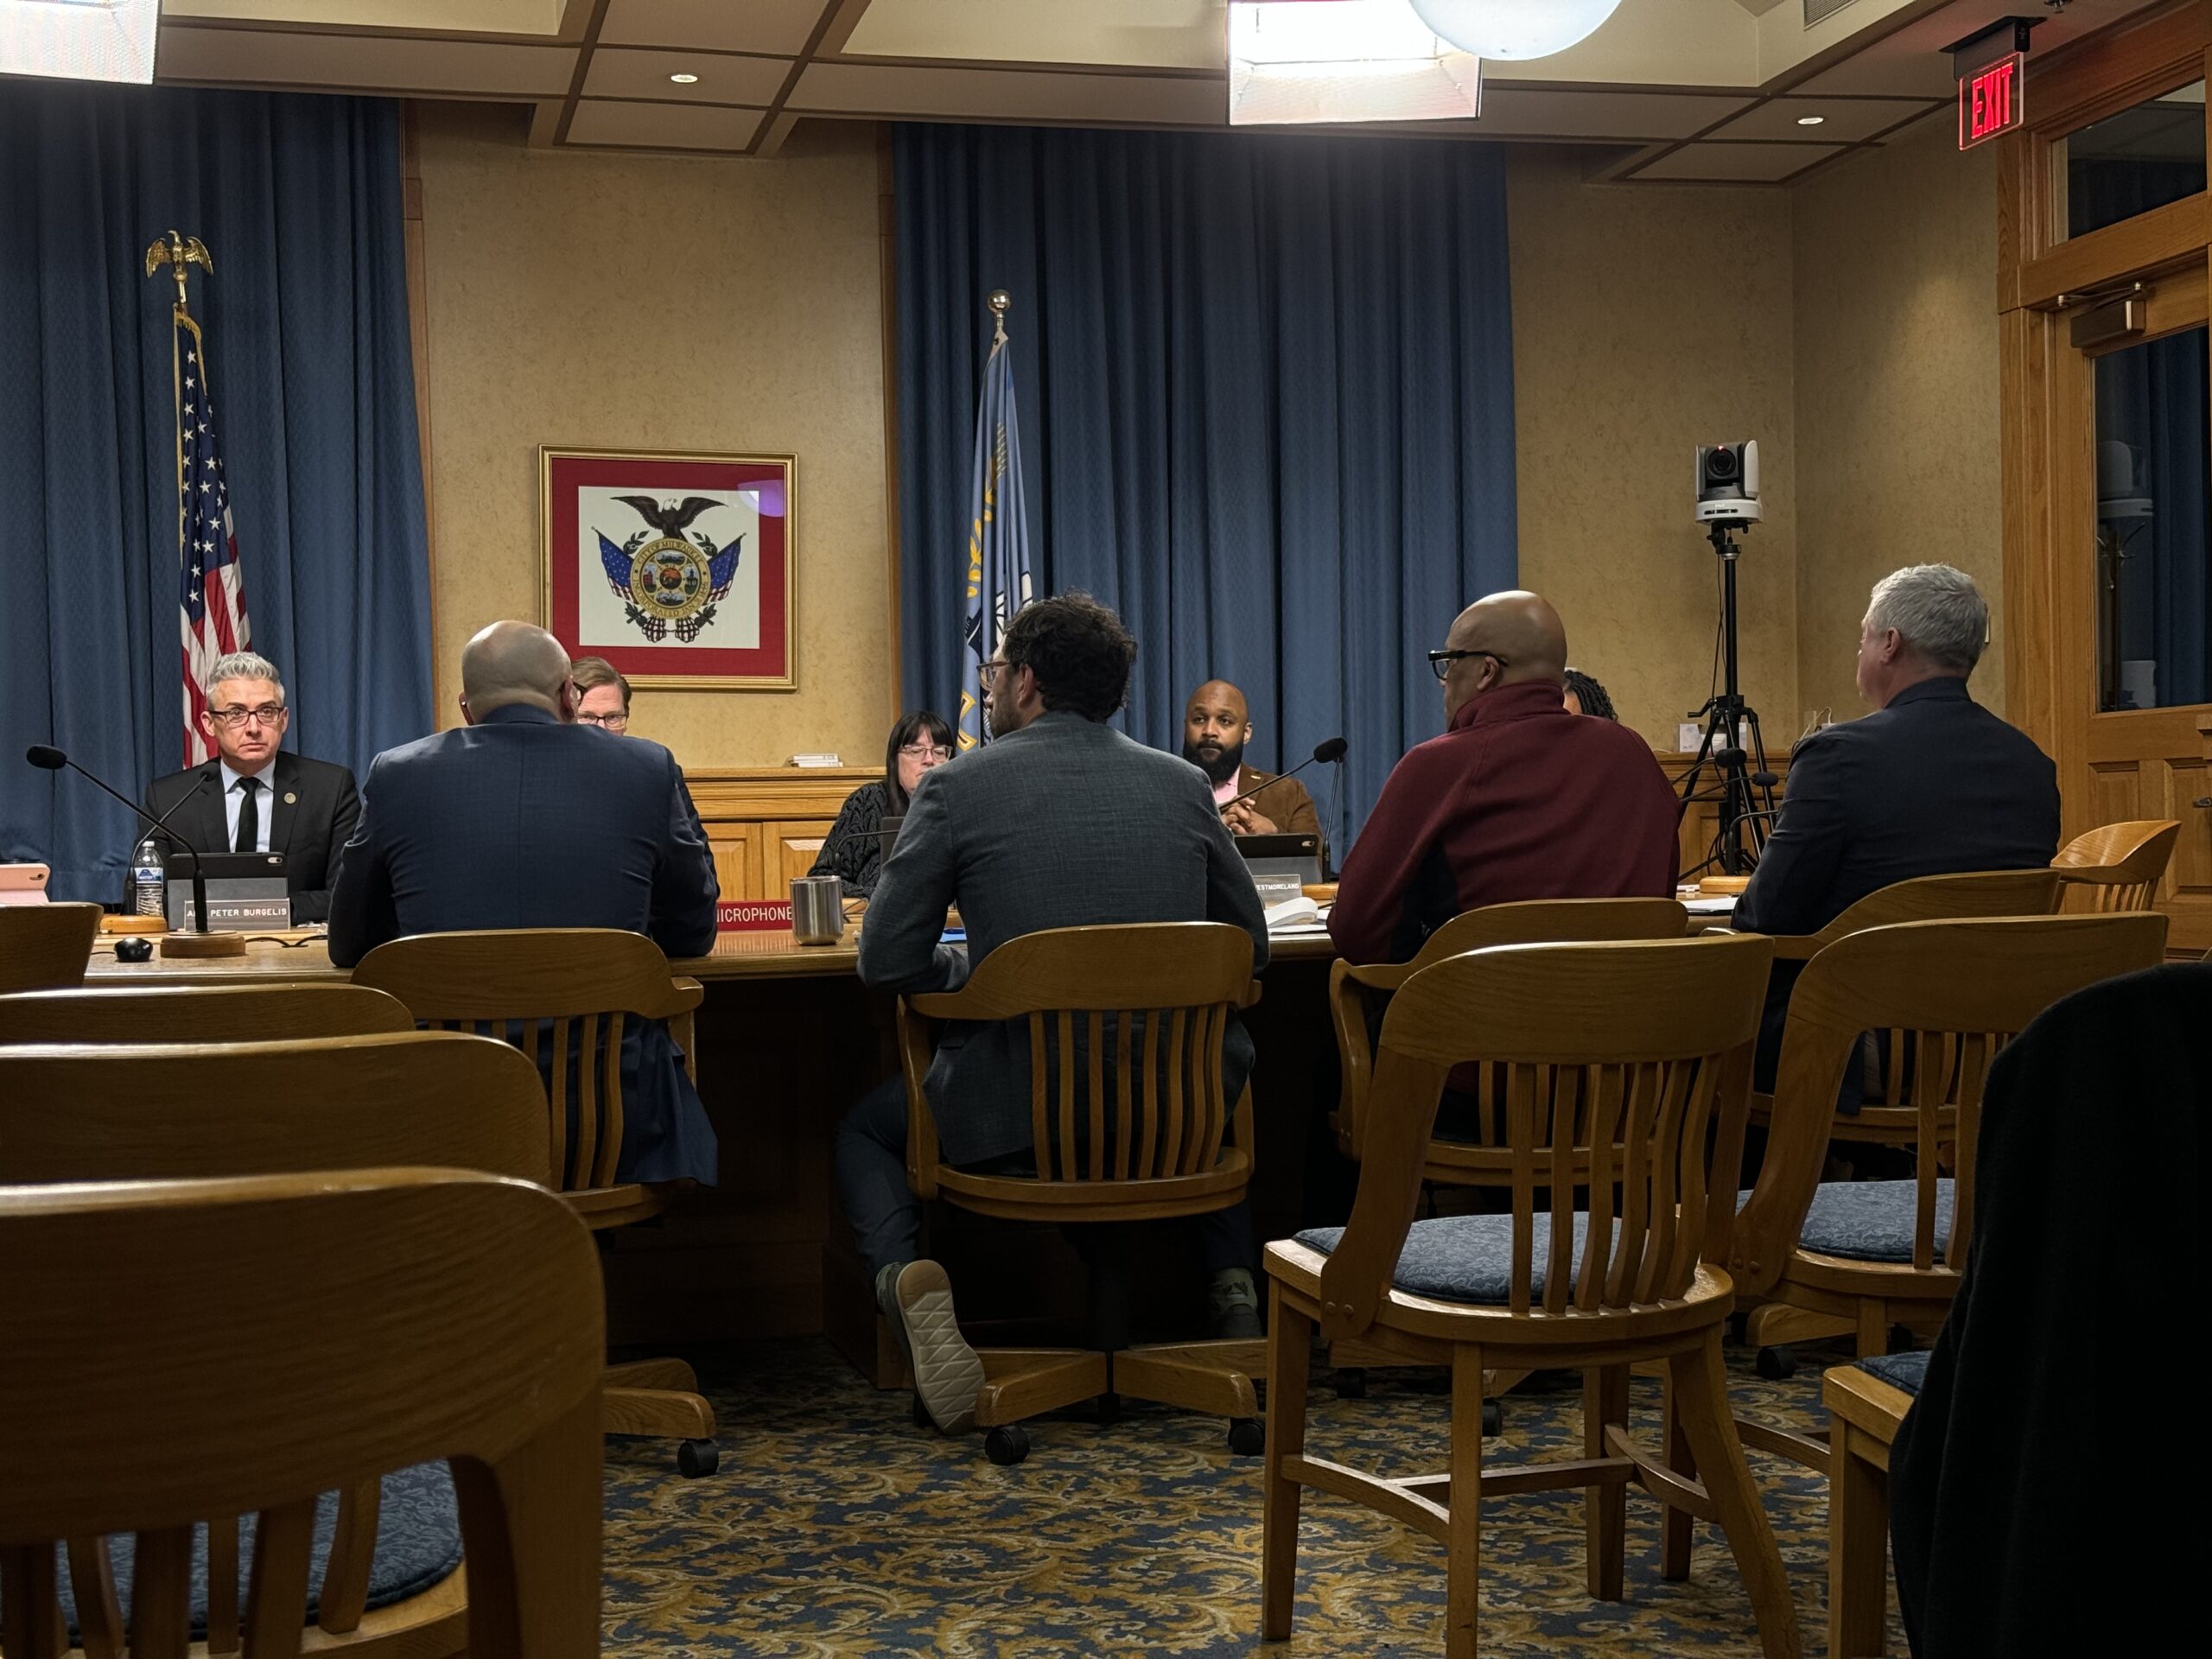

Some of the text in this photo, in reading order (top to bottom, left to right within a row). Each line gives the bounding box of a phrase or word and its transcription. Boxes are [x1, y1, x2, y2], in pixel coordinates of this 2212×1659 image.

[1972, 62, 2013, 139] EXIT
[243, 907, 287, 916] BURGELIS
[716, 906, 793, 923] ICROPHONE
